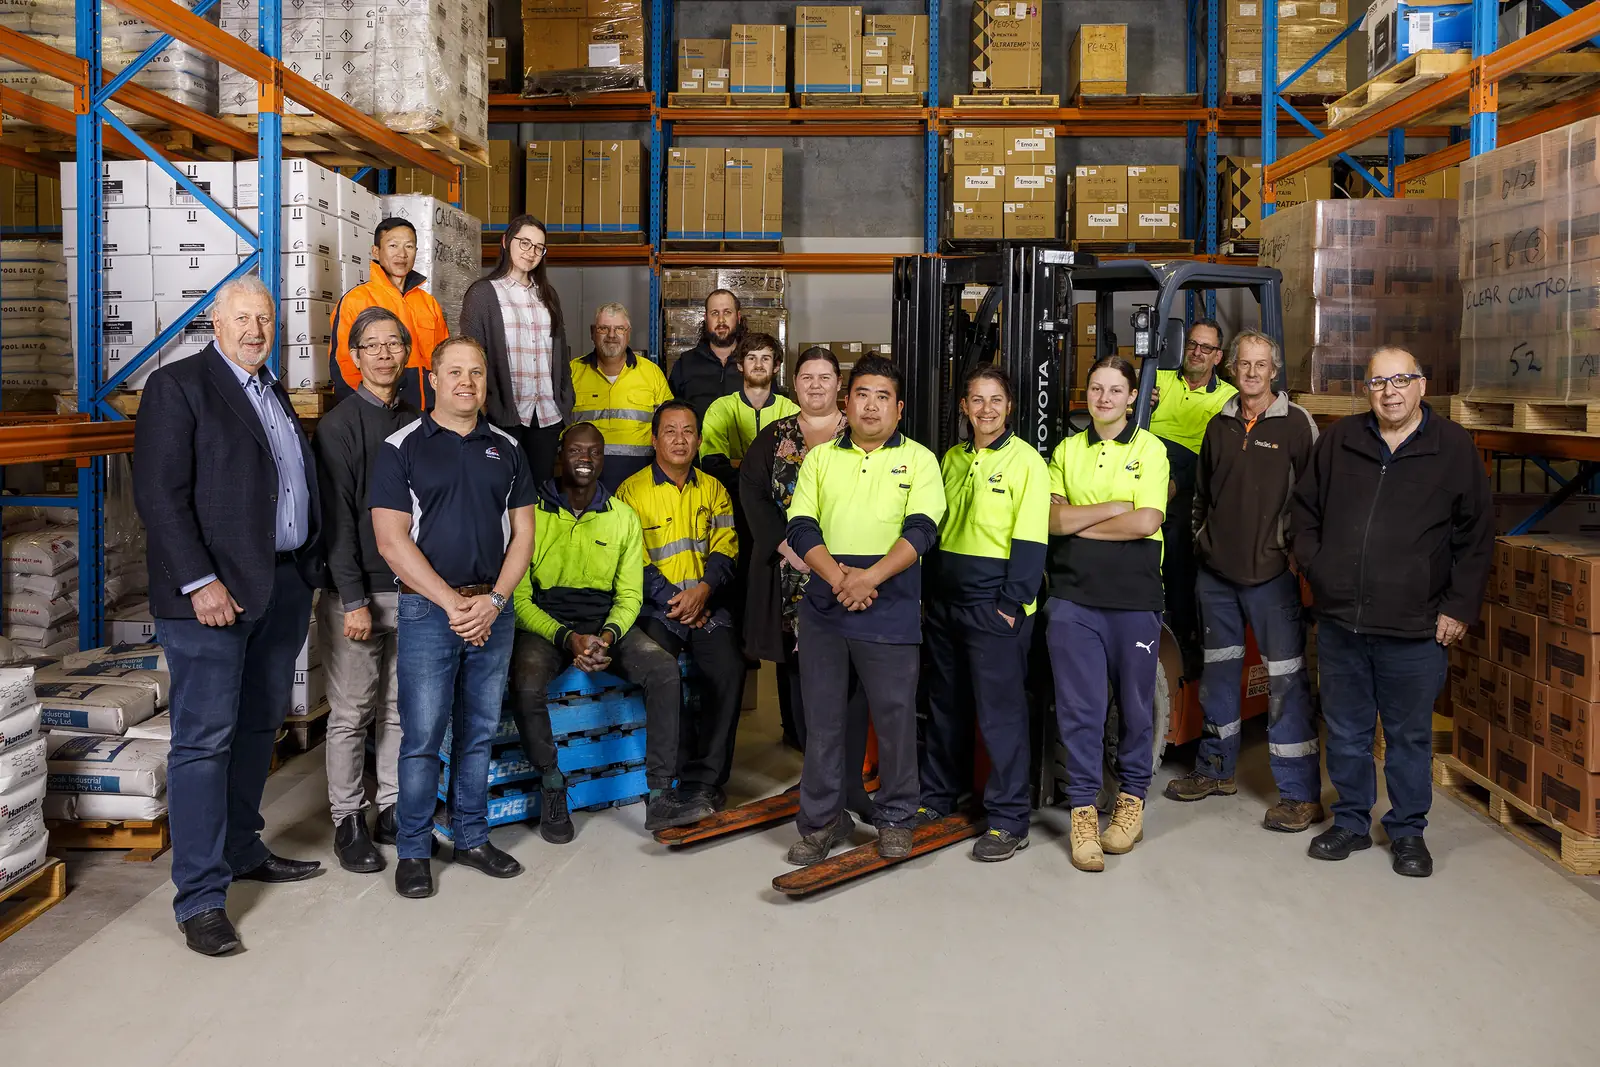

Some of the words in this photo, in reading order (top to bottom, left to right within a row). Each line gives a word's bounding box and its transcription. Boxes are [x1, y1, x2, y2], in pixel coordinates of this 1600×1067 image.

[1466, 285, 1502, 310] CLEAR
[1508, 276, 1581, 304] CONTROL
[1509, 341, 1543, 377] 52
[1037, 360, 1049, 454] TOYOTA
[42, 710, 71, 718] ndustrial
[47, 717, 59, 726] Pty
[4, 728, 33, 747] Hanson
[68, 775, 102, 784] Industrial
[76, 784, 88, 792] Pty
[8, 797, 38, 819] Hanson
[488, 795, 537, 820] CHEP
[6, 858, 37, 882] Hanson
